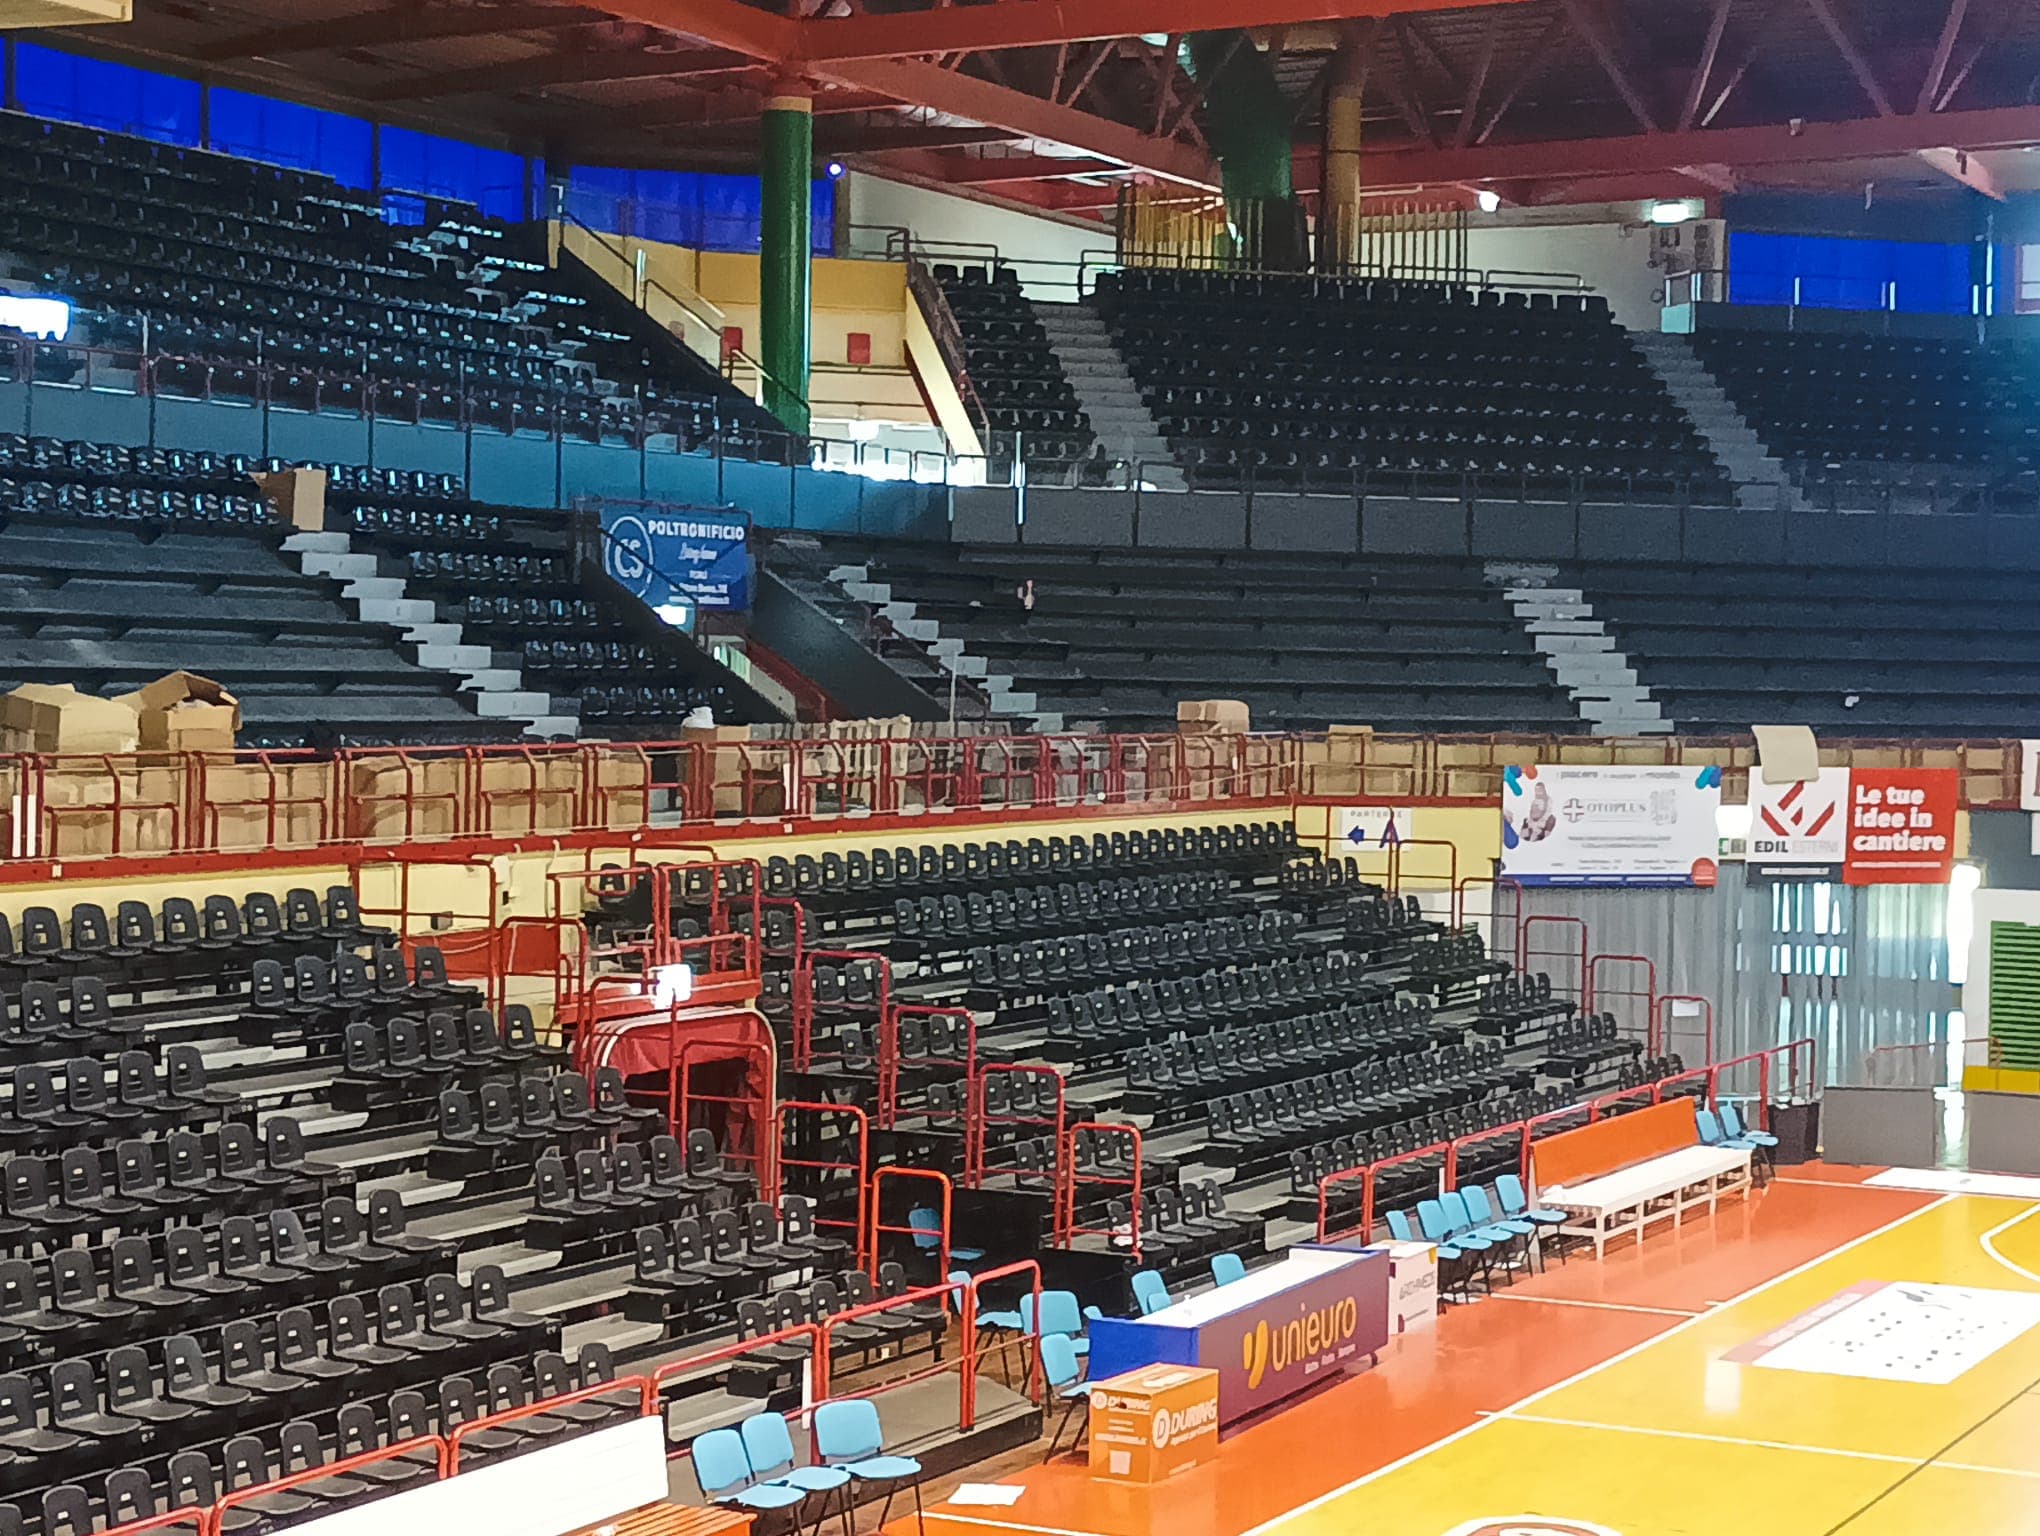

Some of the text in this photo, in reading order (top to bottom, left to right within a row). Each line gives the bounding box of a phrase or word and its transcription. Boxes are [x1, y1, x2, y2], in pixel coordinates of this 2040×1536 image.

[648, 520, 745, 541] POLTRONIFICIO
[1856, 785, 1925, 806] Le tue
[1586, 801, 1647, 814] OTOPLUS
[1854, 807, 1933, 829] idee in
[1754, 841, 1789, 853] EDIL
[1852, 831, 1946, 852] cantiere
[1272, 1296, 1357, 1372] unieuro
